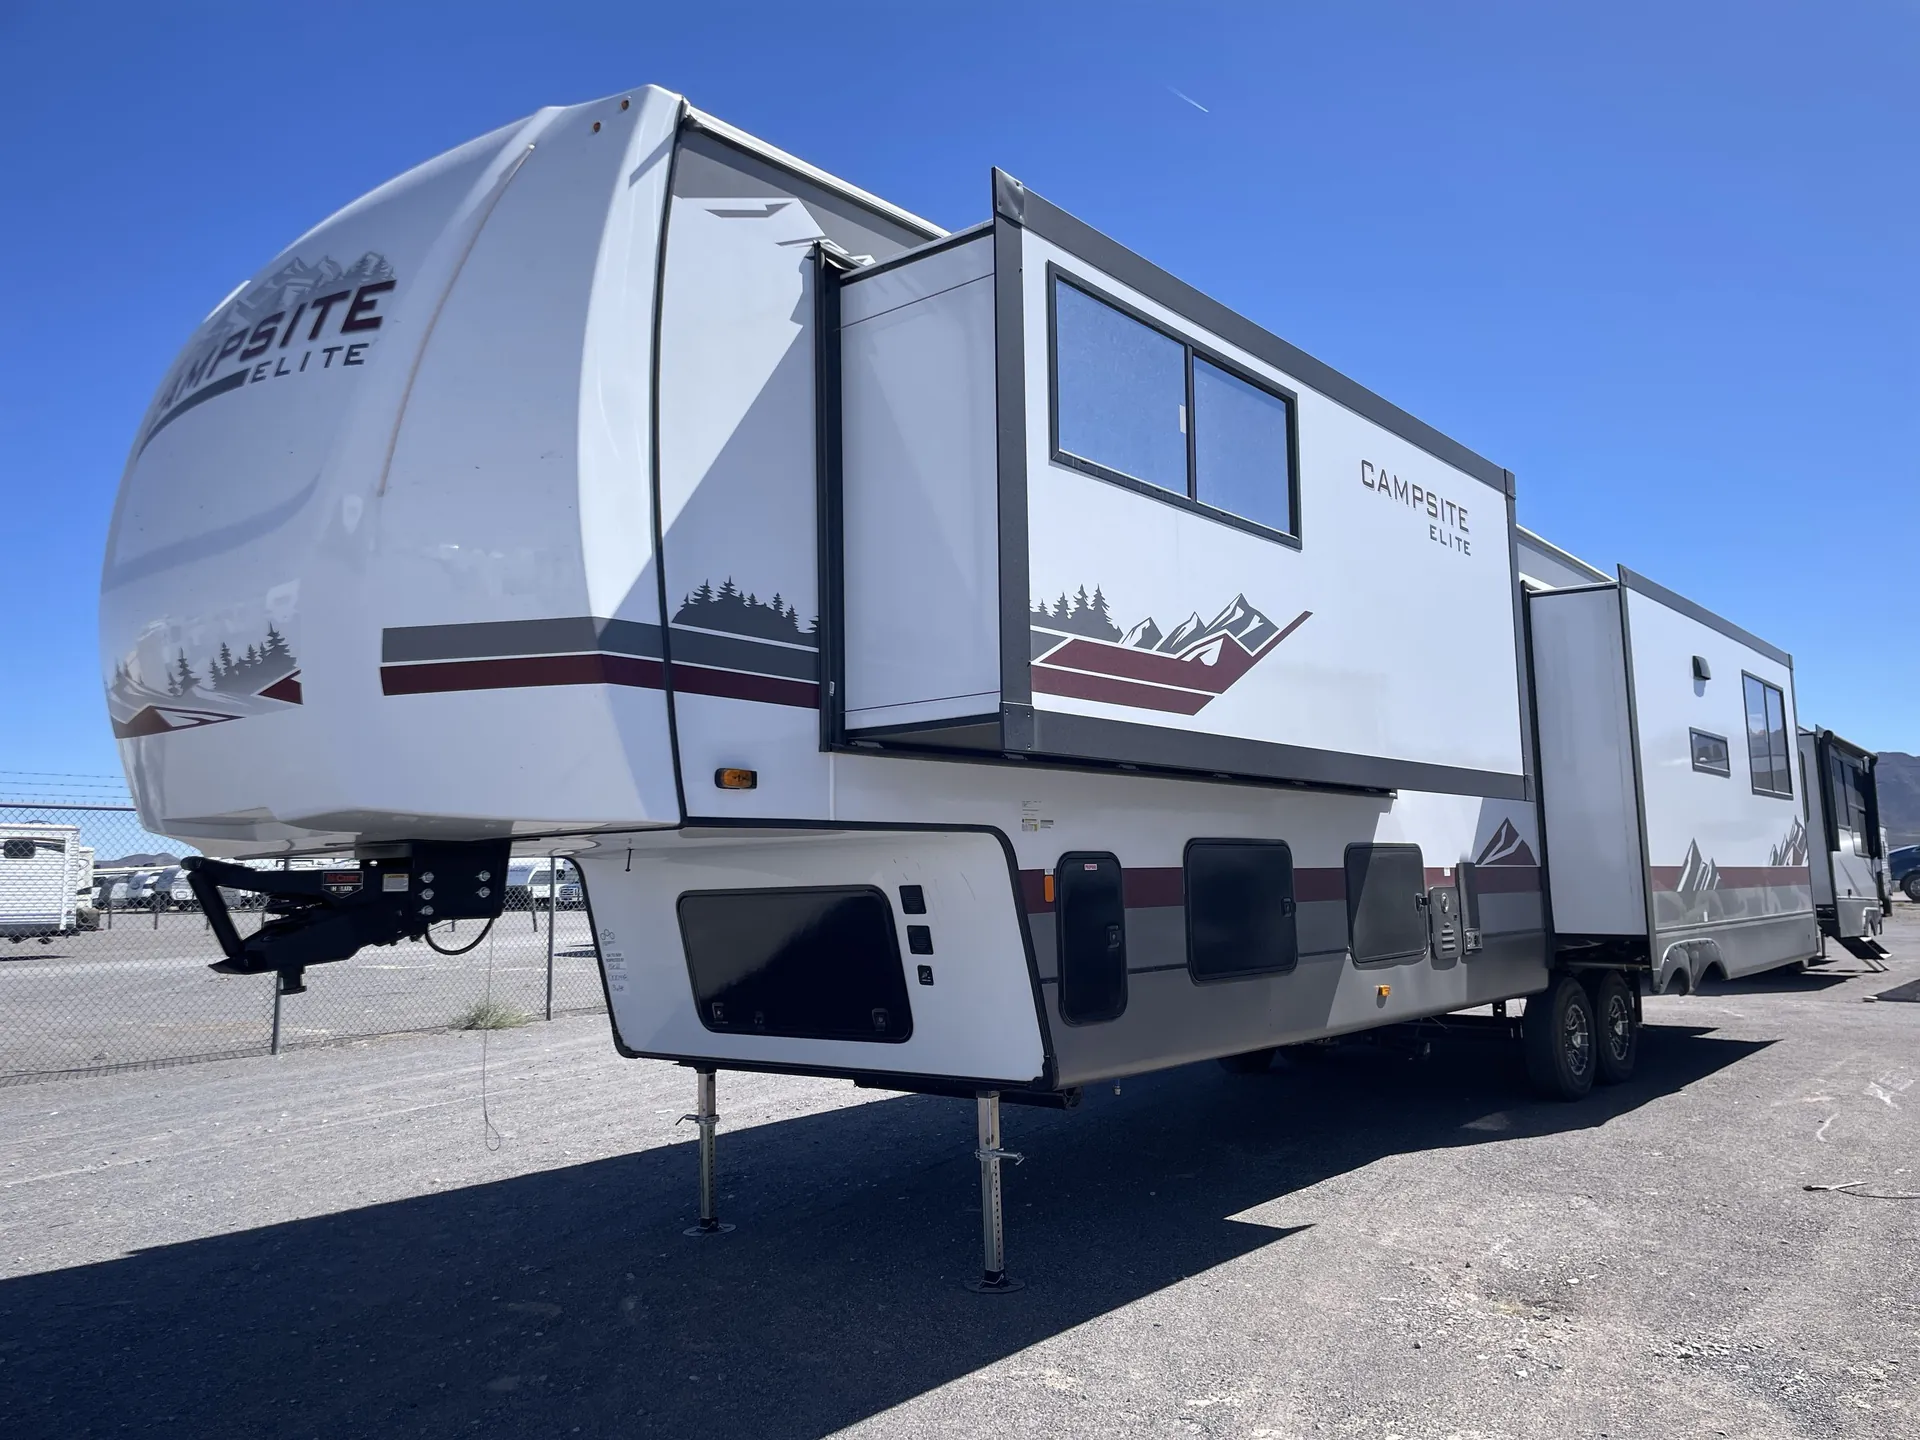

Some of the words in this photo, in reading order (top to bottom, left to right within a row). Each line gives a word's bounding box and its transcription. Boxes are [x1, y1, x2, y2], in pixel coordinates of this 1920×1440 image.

[250, 343, 370, 384] ELITE
[1361, 459, 1470, 533] CAMPSITE
[1429, 523, 1472, 557] ELITE
